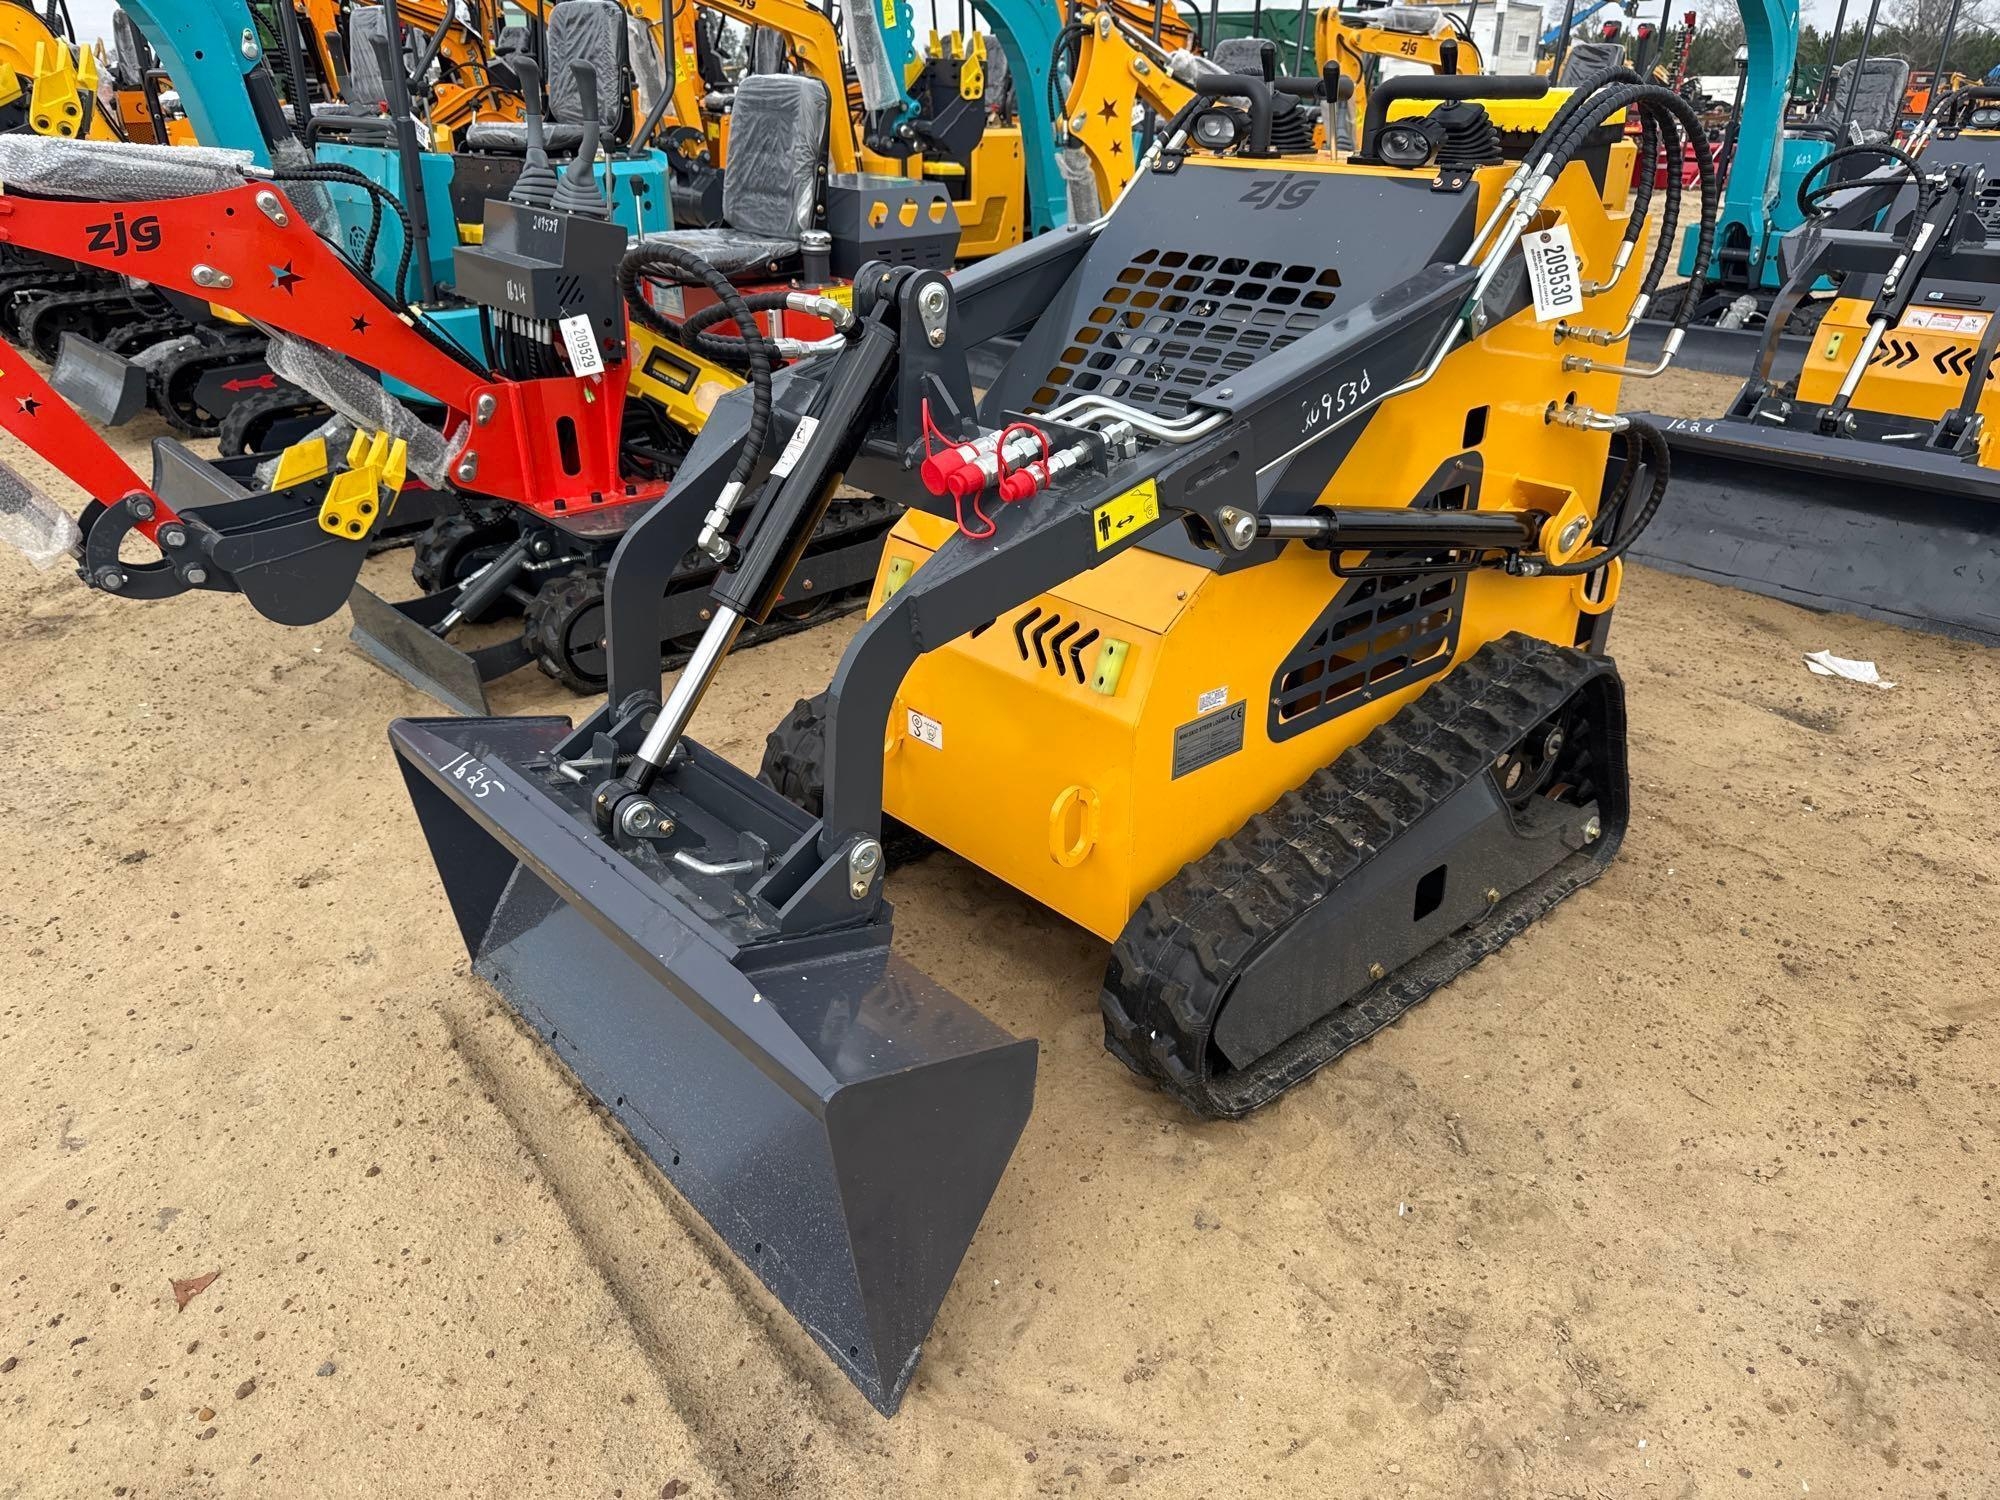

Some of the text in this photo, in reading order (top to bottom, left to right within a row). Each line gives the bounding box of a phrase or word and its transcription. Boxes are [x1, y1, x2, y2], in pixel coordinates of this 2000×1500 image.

[1401, 38, 1418, 55] zjg
[1238, 173, 1321, 210] zjg
[85, 212, 161, 256] zjg
[1543, 245, 1573, 306] 209530
[574, 328, 596, 368] 209529
[1667, 419, 1714, 433] 1626
[440, 752, 505, 797] 1625
